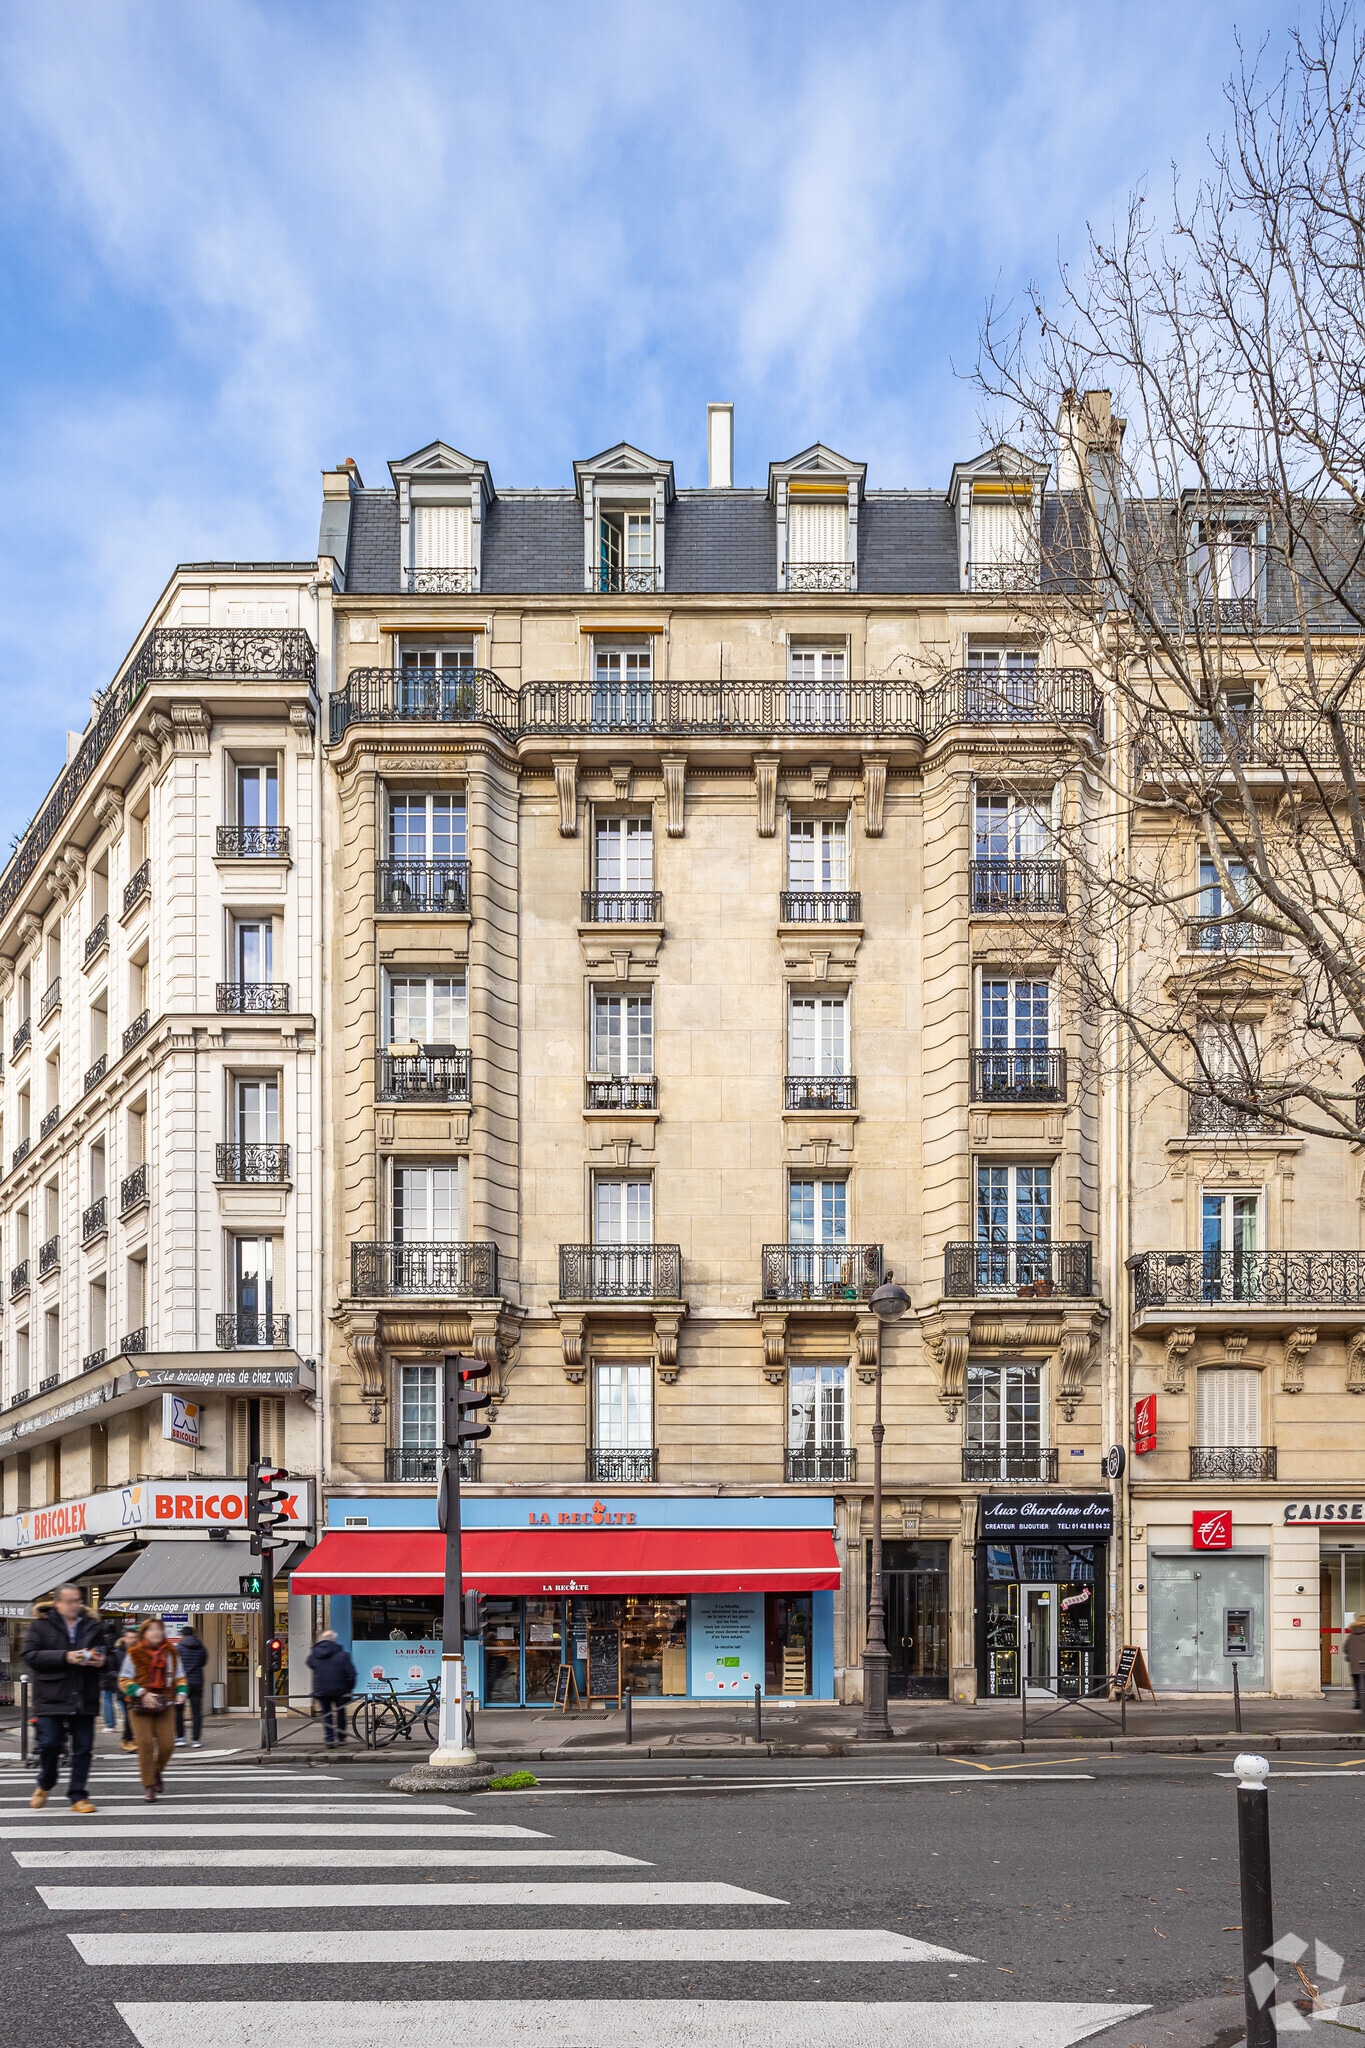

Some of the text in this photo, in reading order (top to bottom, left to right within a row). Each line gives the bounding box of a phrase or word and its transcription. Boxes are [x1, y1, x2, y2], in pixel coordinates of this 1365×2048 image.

[164, 1369, 294, 1386] Le bricolage près de chez vous
[172, 1428, 198, 1444] BRICOLEX
[984, 1502, 1110, 1516] Aux Chardons d'or
[1284, 1504, 1363, 1520] CAISSE
[528, 1512, 550, 1524] LA
[129, 1601, 260, 1613] Le bricolage près de chez vous
